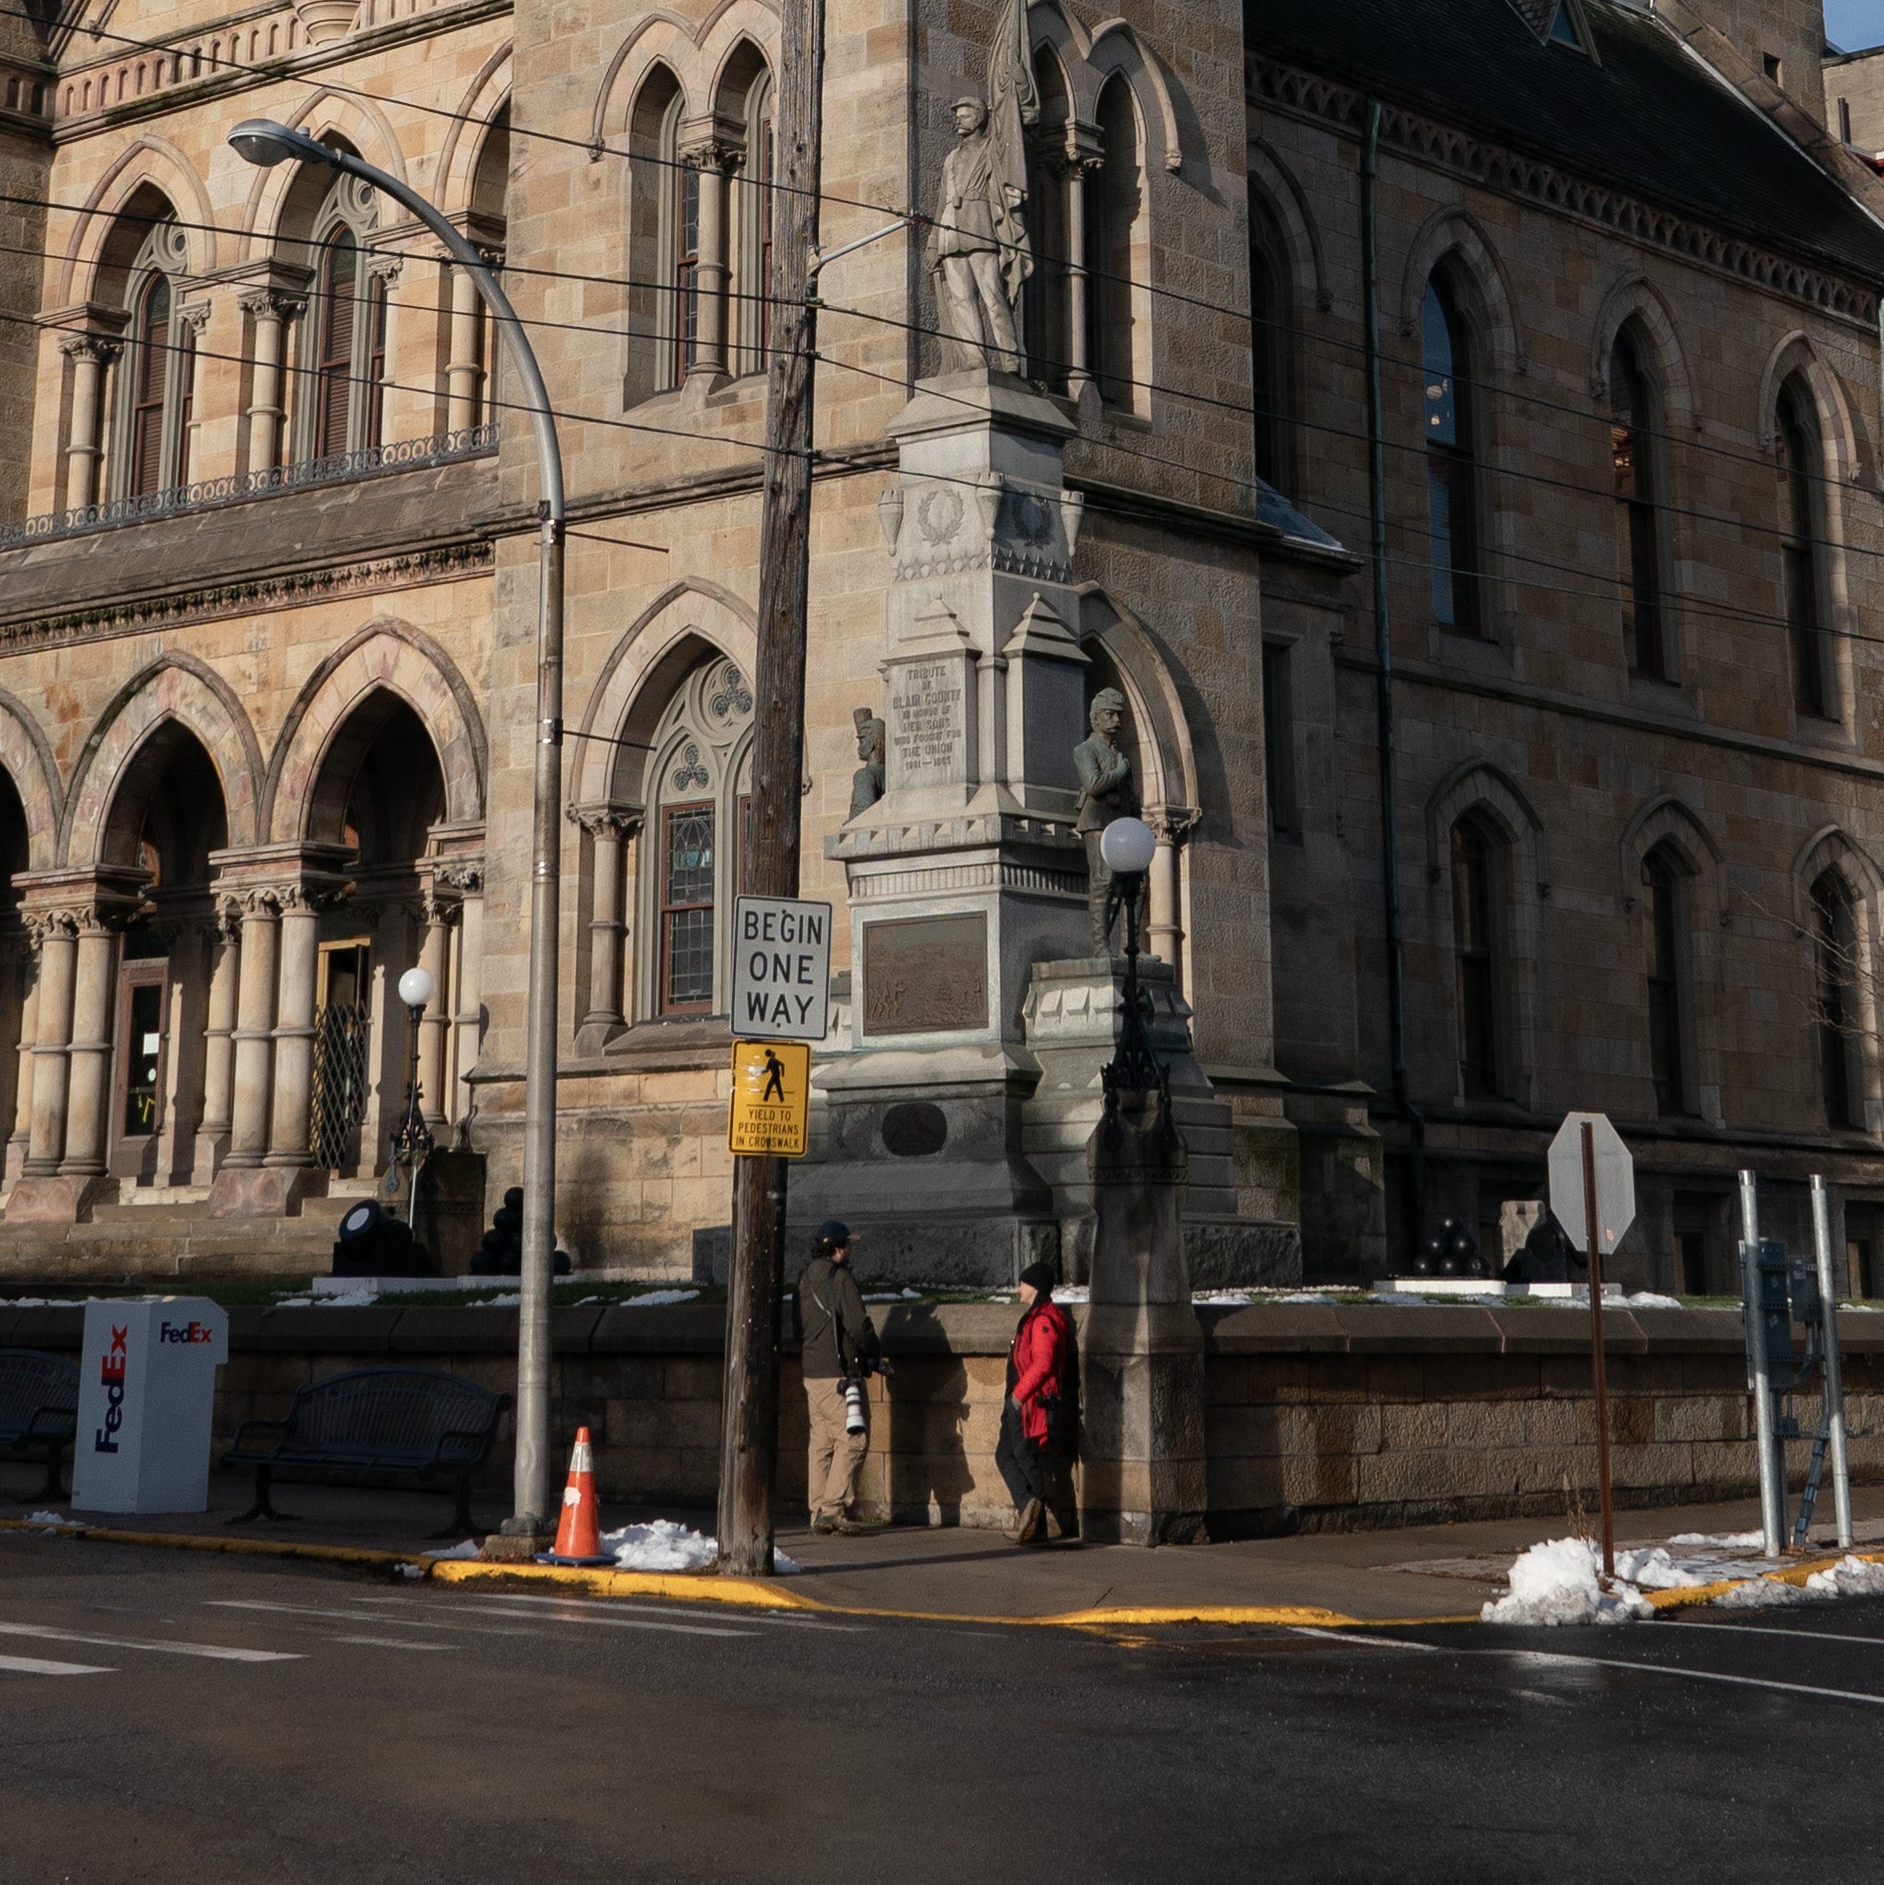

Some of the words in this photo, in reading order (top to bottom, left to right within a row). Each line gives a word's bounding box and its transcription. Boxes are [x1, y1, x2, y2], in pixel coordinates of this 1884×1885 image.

[907, 665, 946, 680] TRIBUTE
[893, 694, 920, 709] BLAIR
[925, 689, 961, 705] COUNTY
[903, 746, 921, 758] THE
[925, 742, 953, 755] UNION
[744, 910, 822, 945] BEGIN
[749, 951, 814, 985] ONE
[746, 991, 815, 1025] WAY
[748, 1108, 775, 1121] YIELD
[780, 1110, 791, 1122] TO
[738, 1122, 799, 1135] PEDESTRIANS
[736, 1136, 745, 1146] IN
[160, 1322, 213, 1343] FedEx
[94, 1324, 128, 1454] FedEx
